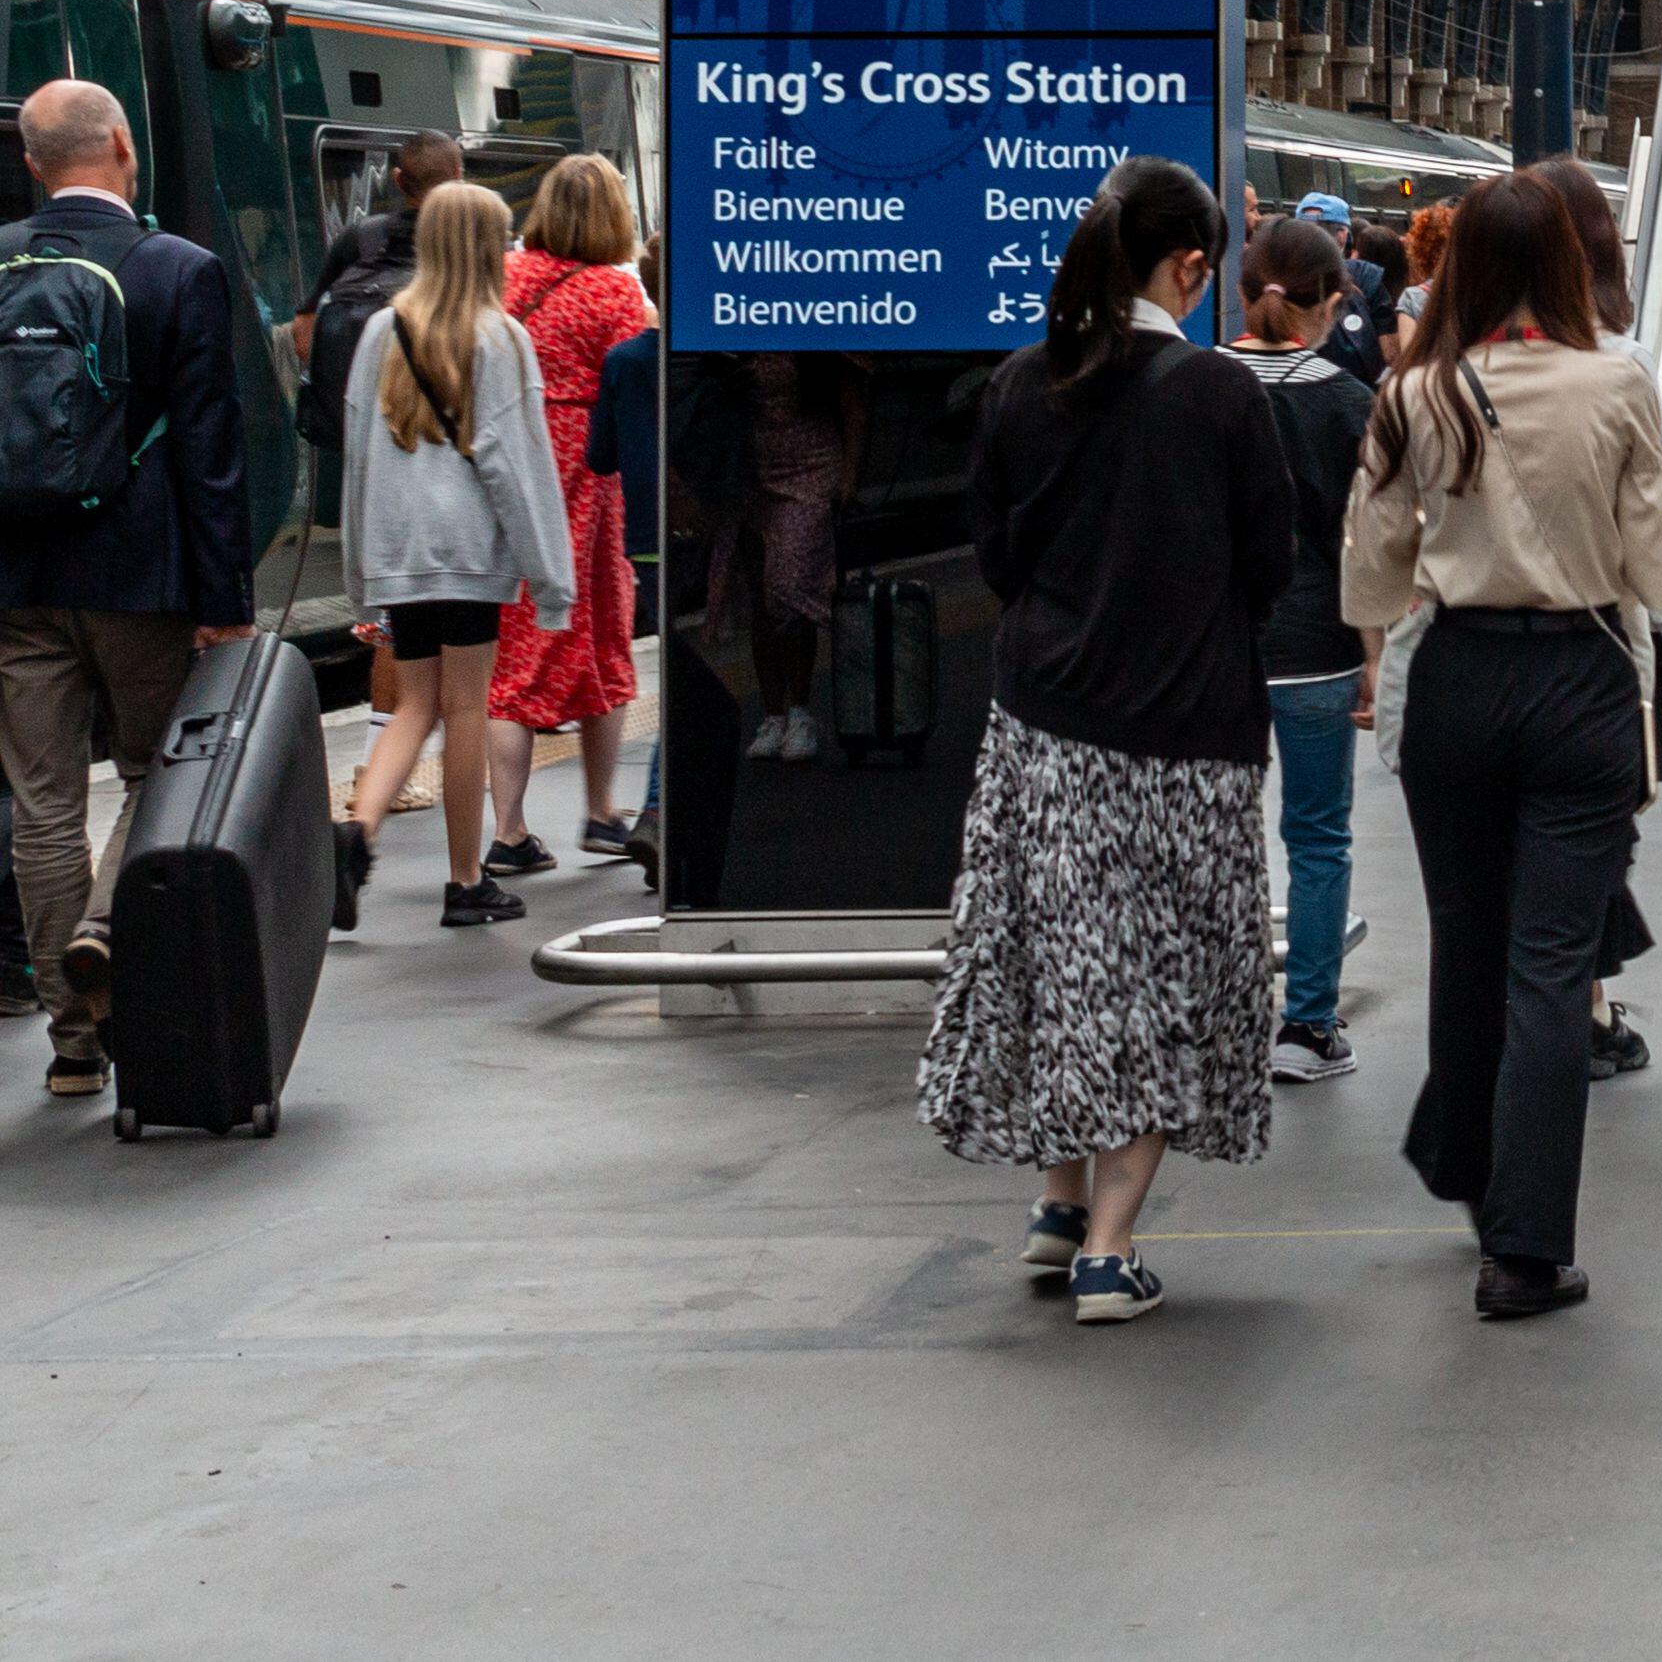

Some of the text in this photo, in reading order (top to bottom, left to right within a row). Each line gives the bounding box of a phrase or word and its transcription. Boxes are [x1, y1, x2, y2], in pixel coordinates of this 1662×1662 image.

[696, 60, 1187, 115] King’s Cross Station
[713, 136, 816, 170] Fàilte
[713, 188, 905, 222] Bienvenue
[985, 188, 1095, 221] Benve
[713, 240, 942, 273] Willkommen
[713, 291, 917, 325] Bienvenido
[987, 291, 1047, 325] よう
